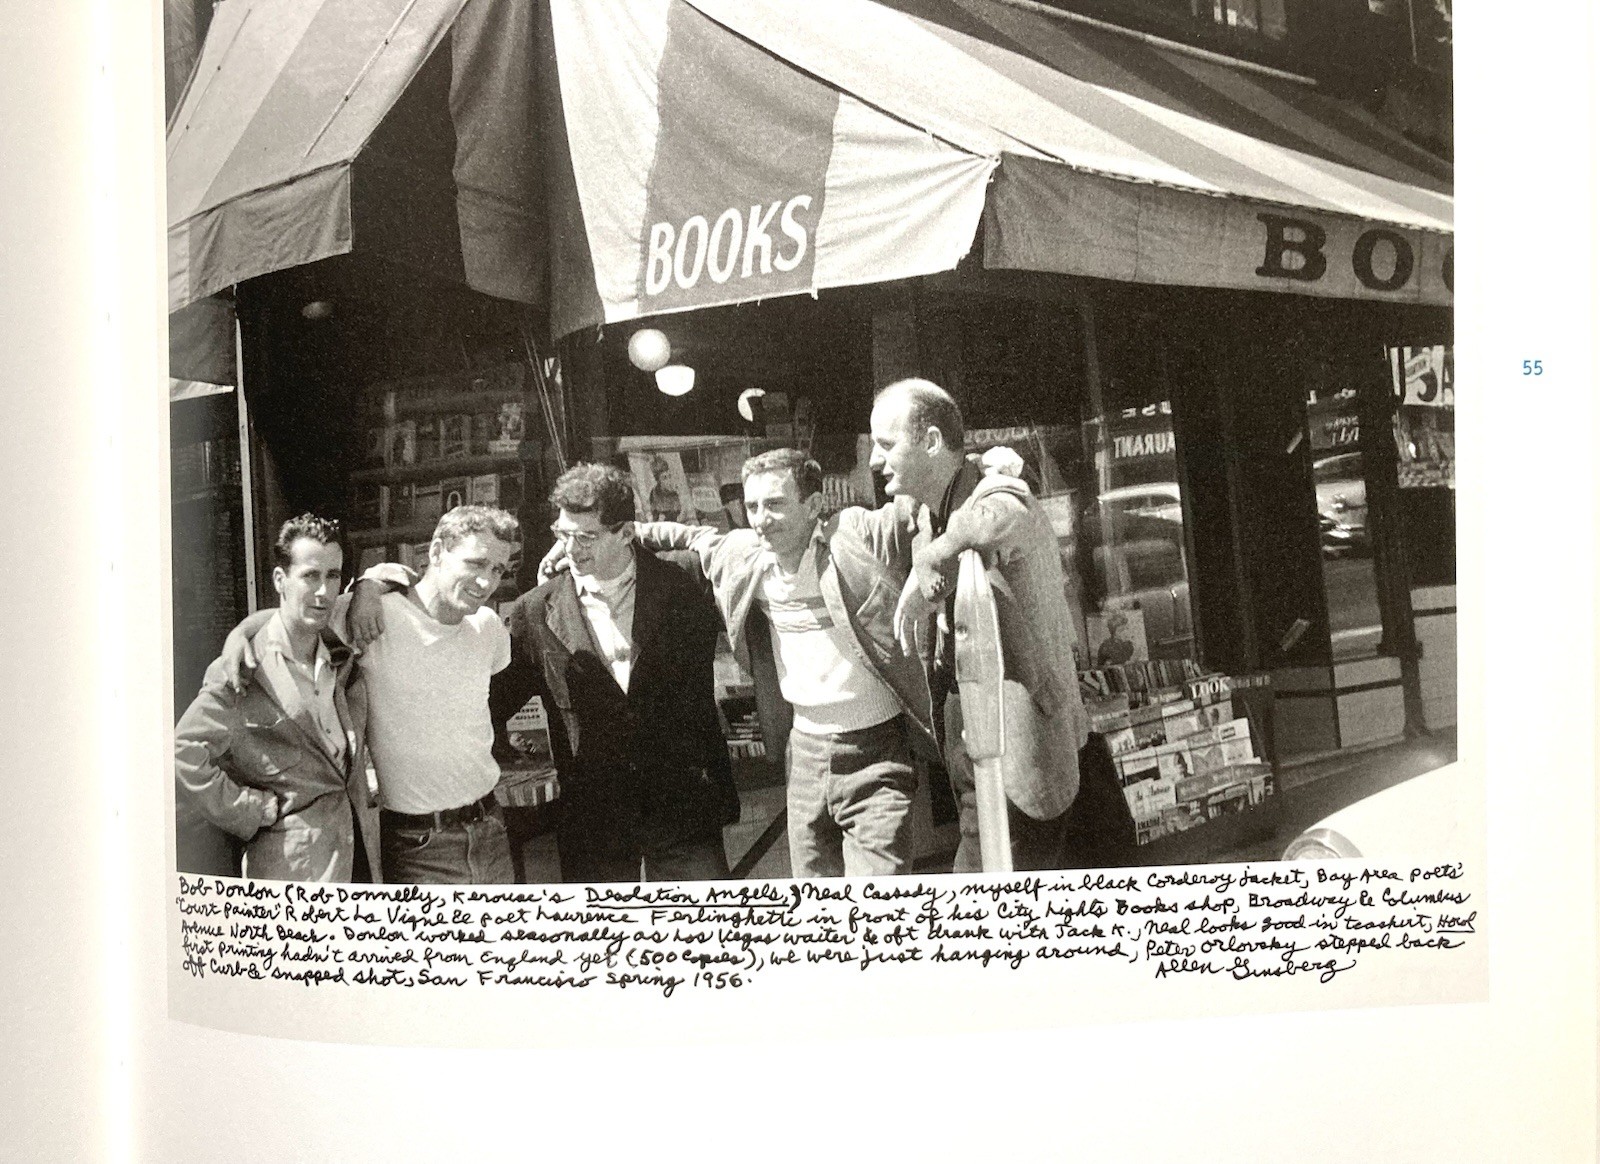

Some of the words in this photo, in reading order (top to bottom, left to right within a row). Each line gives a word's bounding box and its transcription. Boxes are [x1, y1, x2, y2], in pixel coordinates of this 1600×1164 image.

[646, 195, 813, 295] BOOKS
[1255, 212, 1453, 293] BO
[1523, 360, 1543, 375] 55
[1189, 676, 1231, 699] LOOK
[179, 876, 213, 895] Bob
[215, 881, 281, 899] Donlon
[285, 884, 335, 904] (Rob
[337, 886, 446, 913] Donnelly,
[863, 882, 956, 911] Cassady,
[960, 878, 1047, 903] myself
[1048, 876, 1076, 892] in
[1079, 874, 1142, 892] black
[1238, 866, 1309, 890] jacket,
[1317, 868, 1359, 890] Bay
[1359, 869, 1403, 882] Area
[285, 905, 350, 921] Robert
[353, 905, 382, 924] La
[388, 904, 449, 928] Vigne
[807, 908, 842, 925] in
[849, 906, 909, 933] front
[947, 901, 989, 922] his
[997, 902, 1041, 930] City
[1045, 898, 1108, 923] Lights
[1115, 896, 1178, 917] Books
[1248, 892, 1358, 918] Broadway
[1381, 887, 1472, 907] Columbus
[181, 919, 225, 938] Avenue
[229, 925, 273, 941] North
[343, 925, 410, 941] Donlon
[416, 925, 497, 943] worked
[500, 927, 631, 954] seasonally
[633, 929, 670, 943] as
[718, 927, 781, 951] Vegas
[782, 926, 855, 944] waiter
[927, 925, 994, 941] drank
[999, 923, 1049, 941] with
[1055, 923, 1106, 939] Jack
[1195, 916, 1257, 935] looks
[1308, 911, 1338, 931] in
[182, 936, 215, 955] first
[281, 944, 344, 962] hadn't
[348, 946, 419, 964] arrived
[424, 949, 474, 967] from
[480, 949, 568, 970] England
[573, 950, 618, 972] yet
[769, 948, 801, 964] we
[807, 947, 860, 962] were
[860, 945, 923, 971] just
[930, 943, 1031, 969] hanging
[1146, 940, 1197, 960] Peter
[1315, 935, 1394, 954] stepped
[1396, 933, 1466, 950] back
[182, 955, 207, 977] off
[418, 969, 468, 986] San
[1155, 960, 1224, 979] Allen
